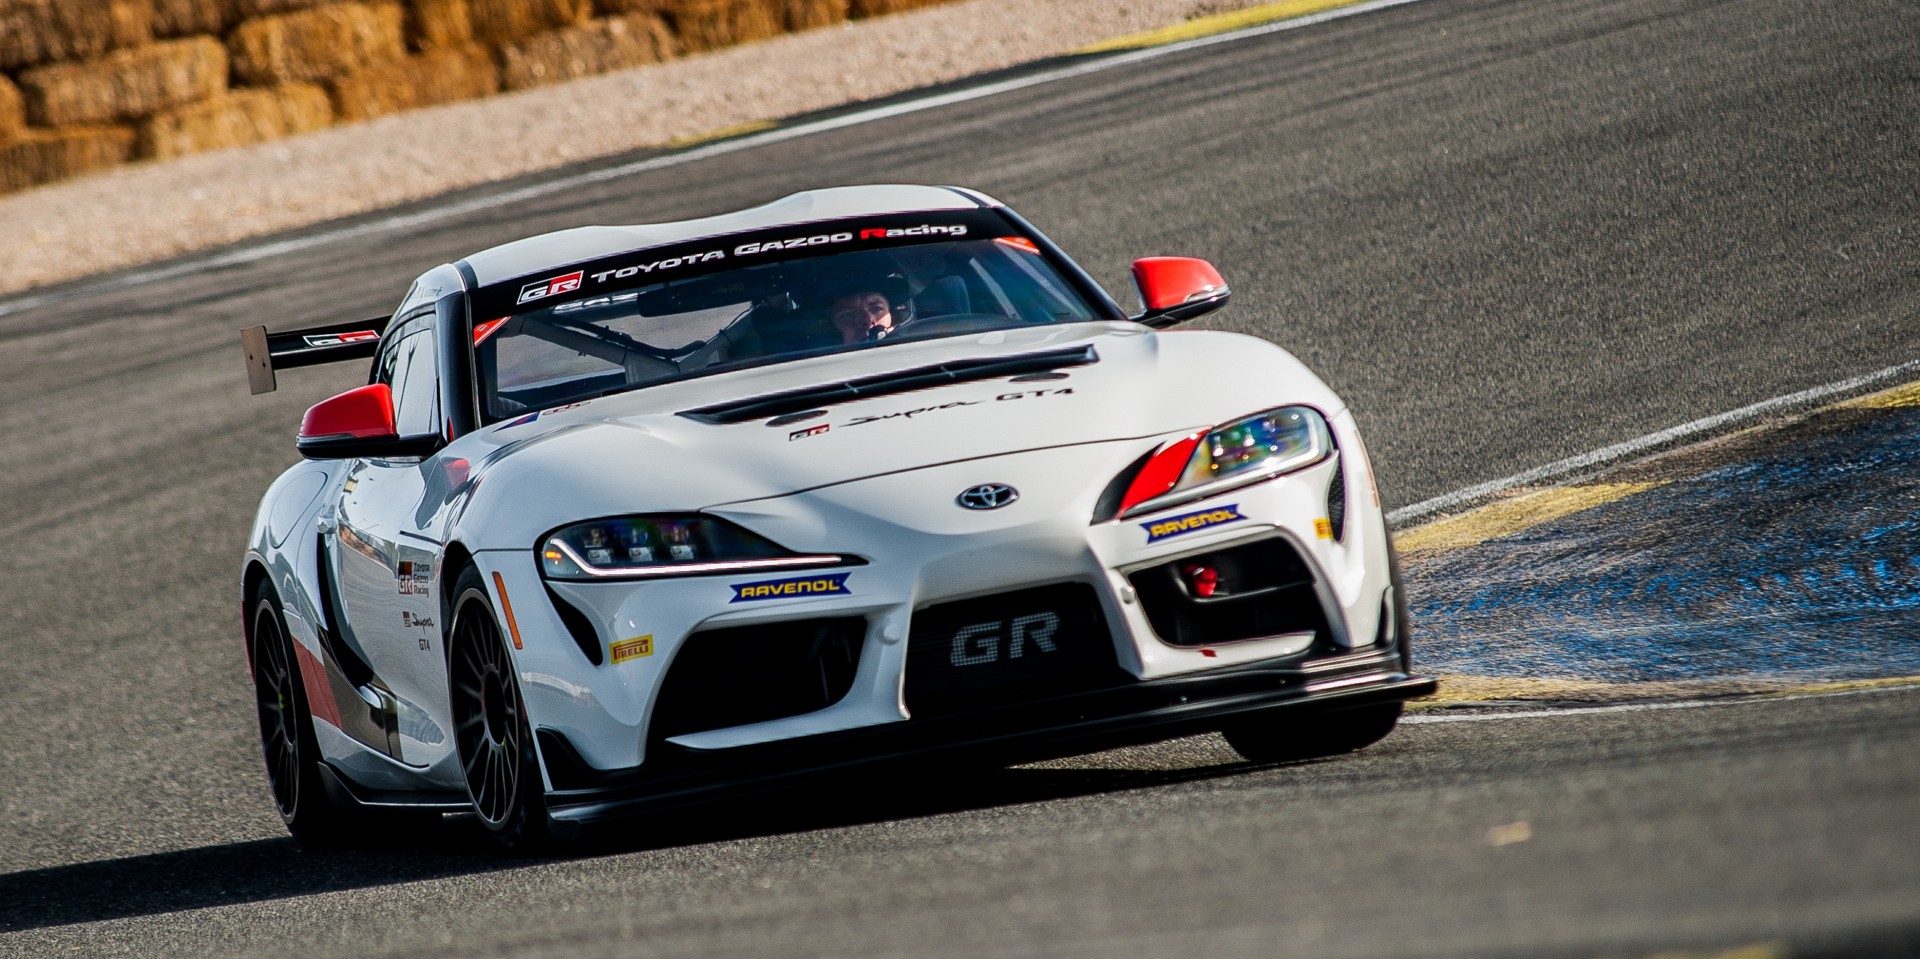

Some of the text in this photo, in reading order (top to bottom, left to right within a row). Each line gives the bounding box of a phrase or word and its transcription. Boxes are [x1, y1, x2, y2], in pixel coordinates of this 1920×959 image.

[591, 223, 967, 283] TOYOTA GAZOO Racing
[519, 277, 580, 302] GR
[838, 400, 986, 427] Supra
[996, 387, 1076, 401] GT4
[1150, 510, 1238, 537] RAVENOL
[741, 579, 840, 598] RAVENOL
[412, 612, 435, 634] Supra
[419, 638, 431, 651] GT4
[613, 639, 649, 660] PIRELLI
[950, 611, 1060, 667] GR
